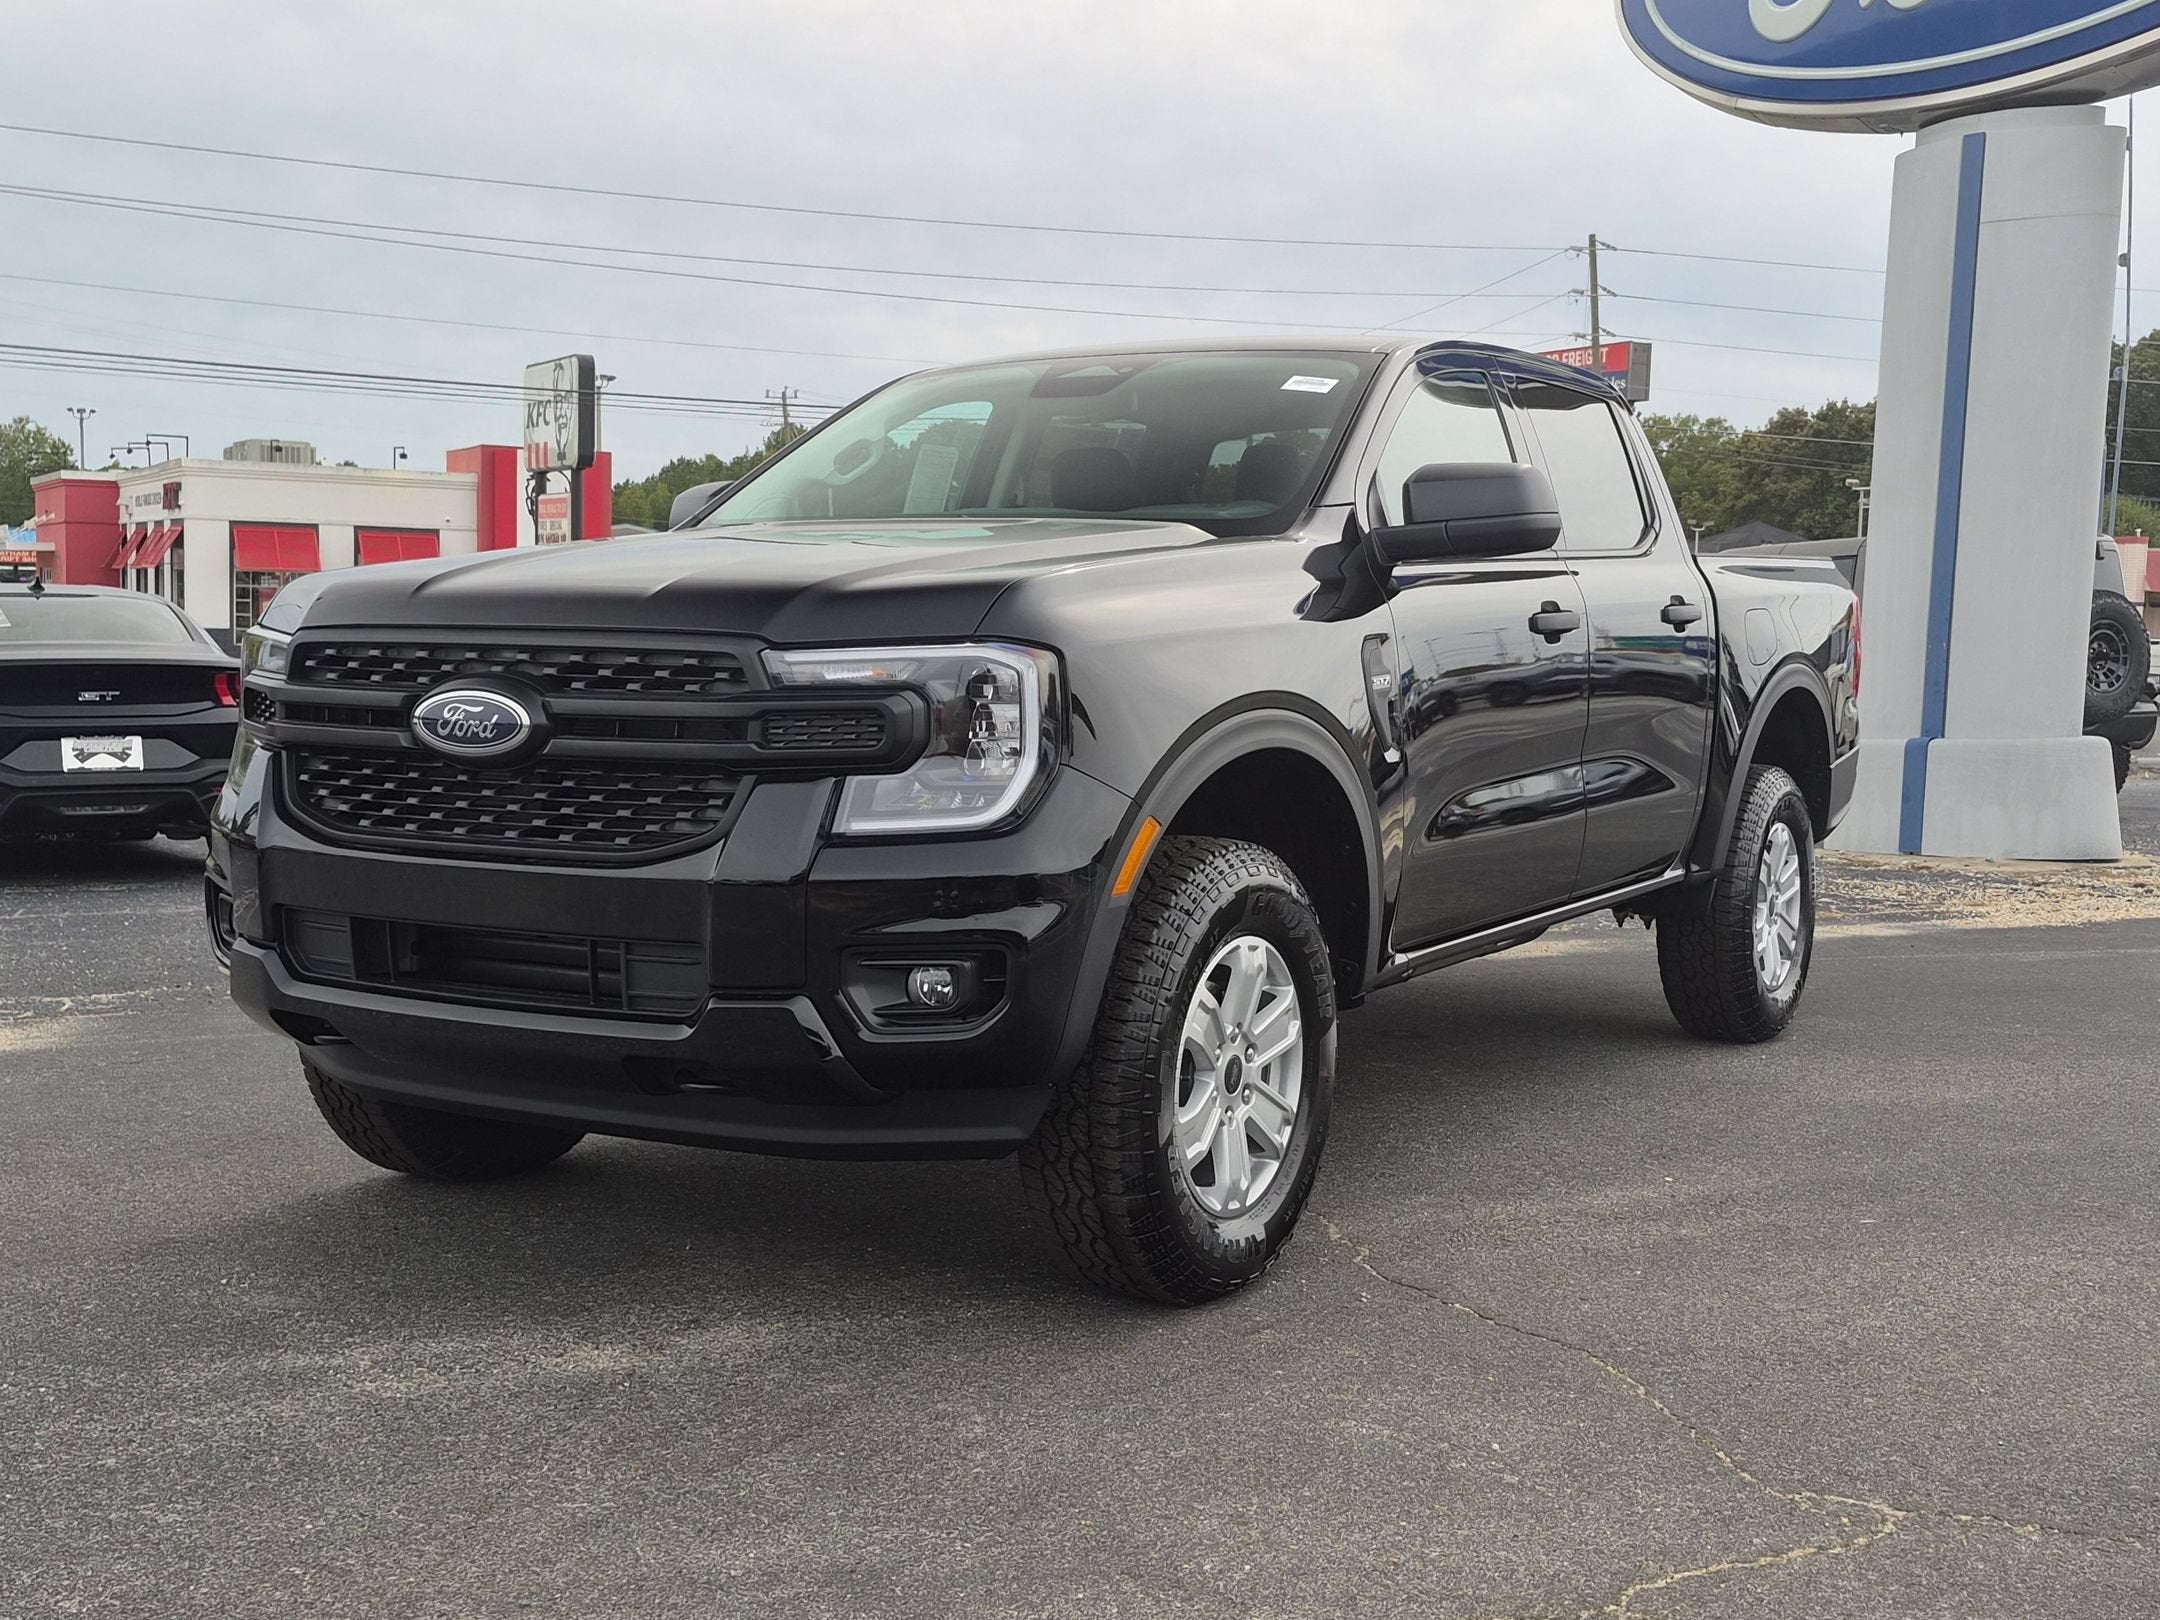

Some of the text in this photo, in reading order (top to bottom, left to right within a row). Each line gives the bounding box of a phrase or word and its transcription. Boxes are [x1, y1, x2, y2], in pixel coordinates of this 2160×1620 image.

[1562, 348, 1608, 366] FREIGT
[526, 399, 552, 430] KFC
[78, 691, 120, 702] GT
[437, 702, 498, 738] Ford
